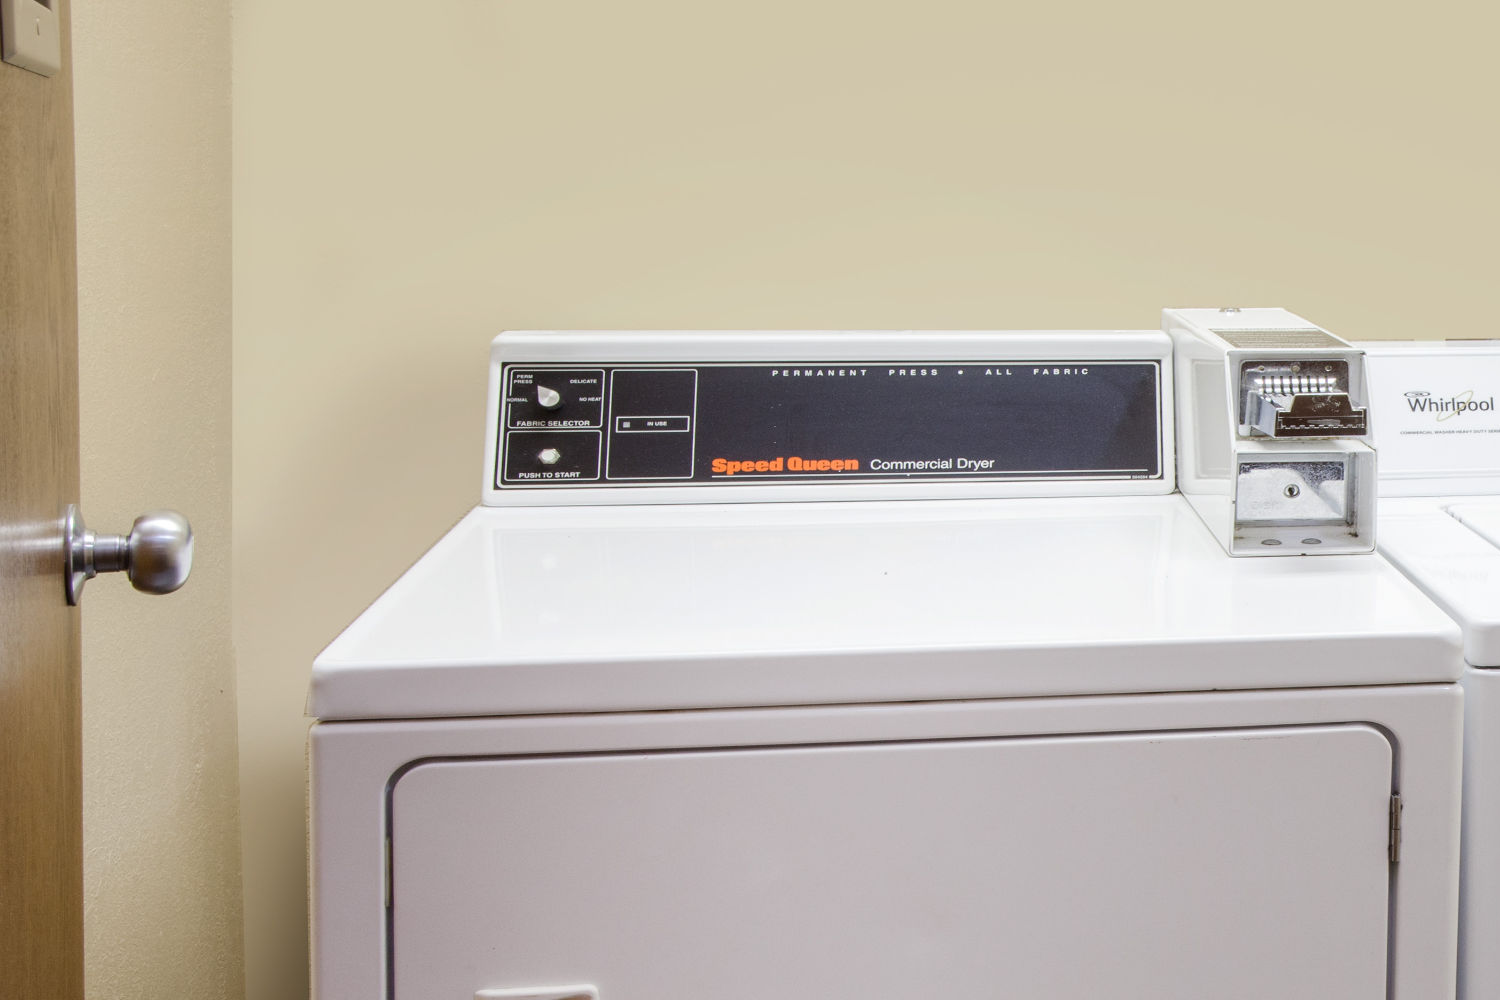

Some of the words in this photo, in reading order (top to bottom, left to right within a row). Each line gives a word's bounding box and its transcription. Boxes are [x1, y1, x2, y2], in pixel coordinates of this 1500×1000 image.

[772, 369, 867, 377] PERMANENT
[1033, 368, 1089, 376] FABRIC
[1407, 396, 1495, 416] Whirlpool
[711, 457, 784, 475] Speed
[787, 456, 859, 472] Queen
[870, 458, 953, 471] Commercial
[956, 457, 995, 471] Dryer
[554, 471, 581, 479] START
